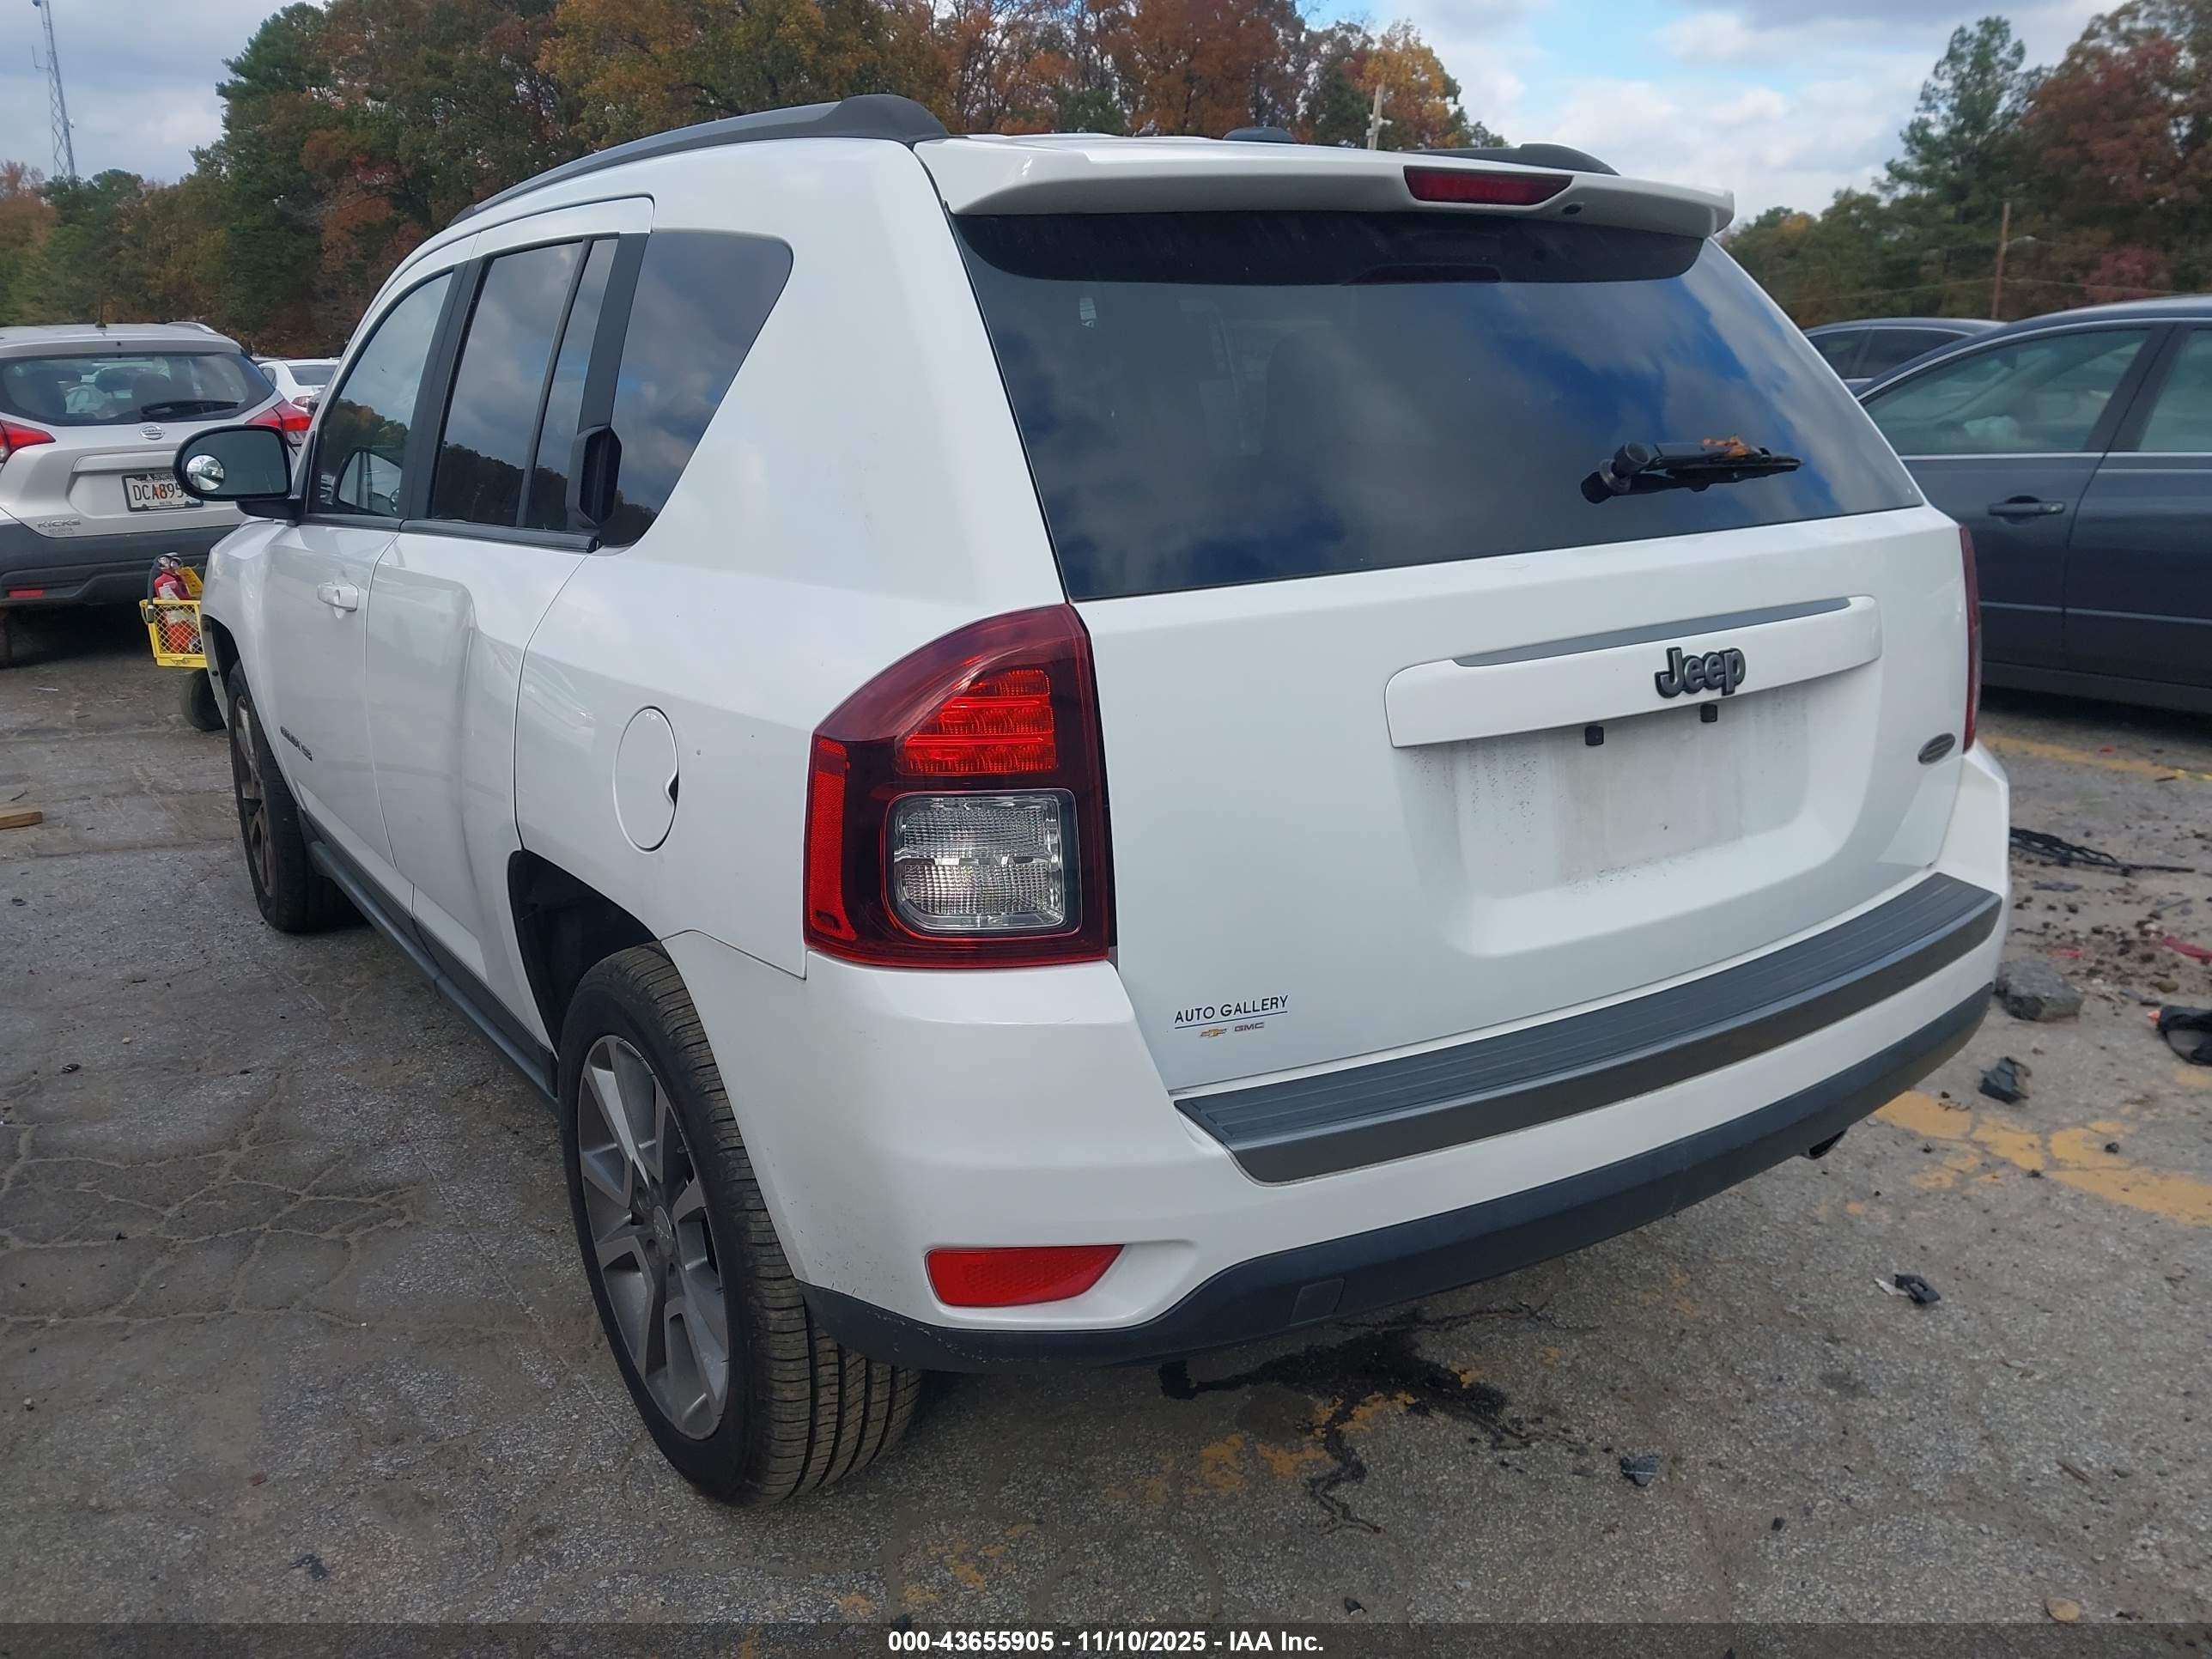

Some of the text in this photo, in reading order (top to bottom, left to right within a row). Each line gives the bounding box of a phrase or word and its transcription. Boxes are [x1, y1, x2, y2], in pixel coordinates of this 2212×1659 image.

[132, 483, 191, 501] DCA895
[1654, 647, 1746, 698] Jeep
[1174, 994, 1289, 1024] AUTO GALLERY
[1234, 1022, 1265, 1032] GMC
